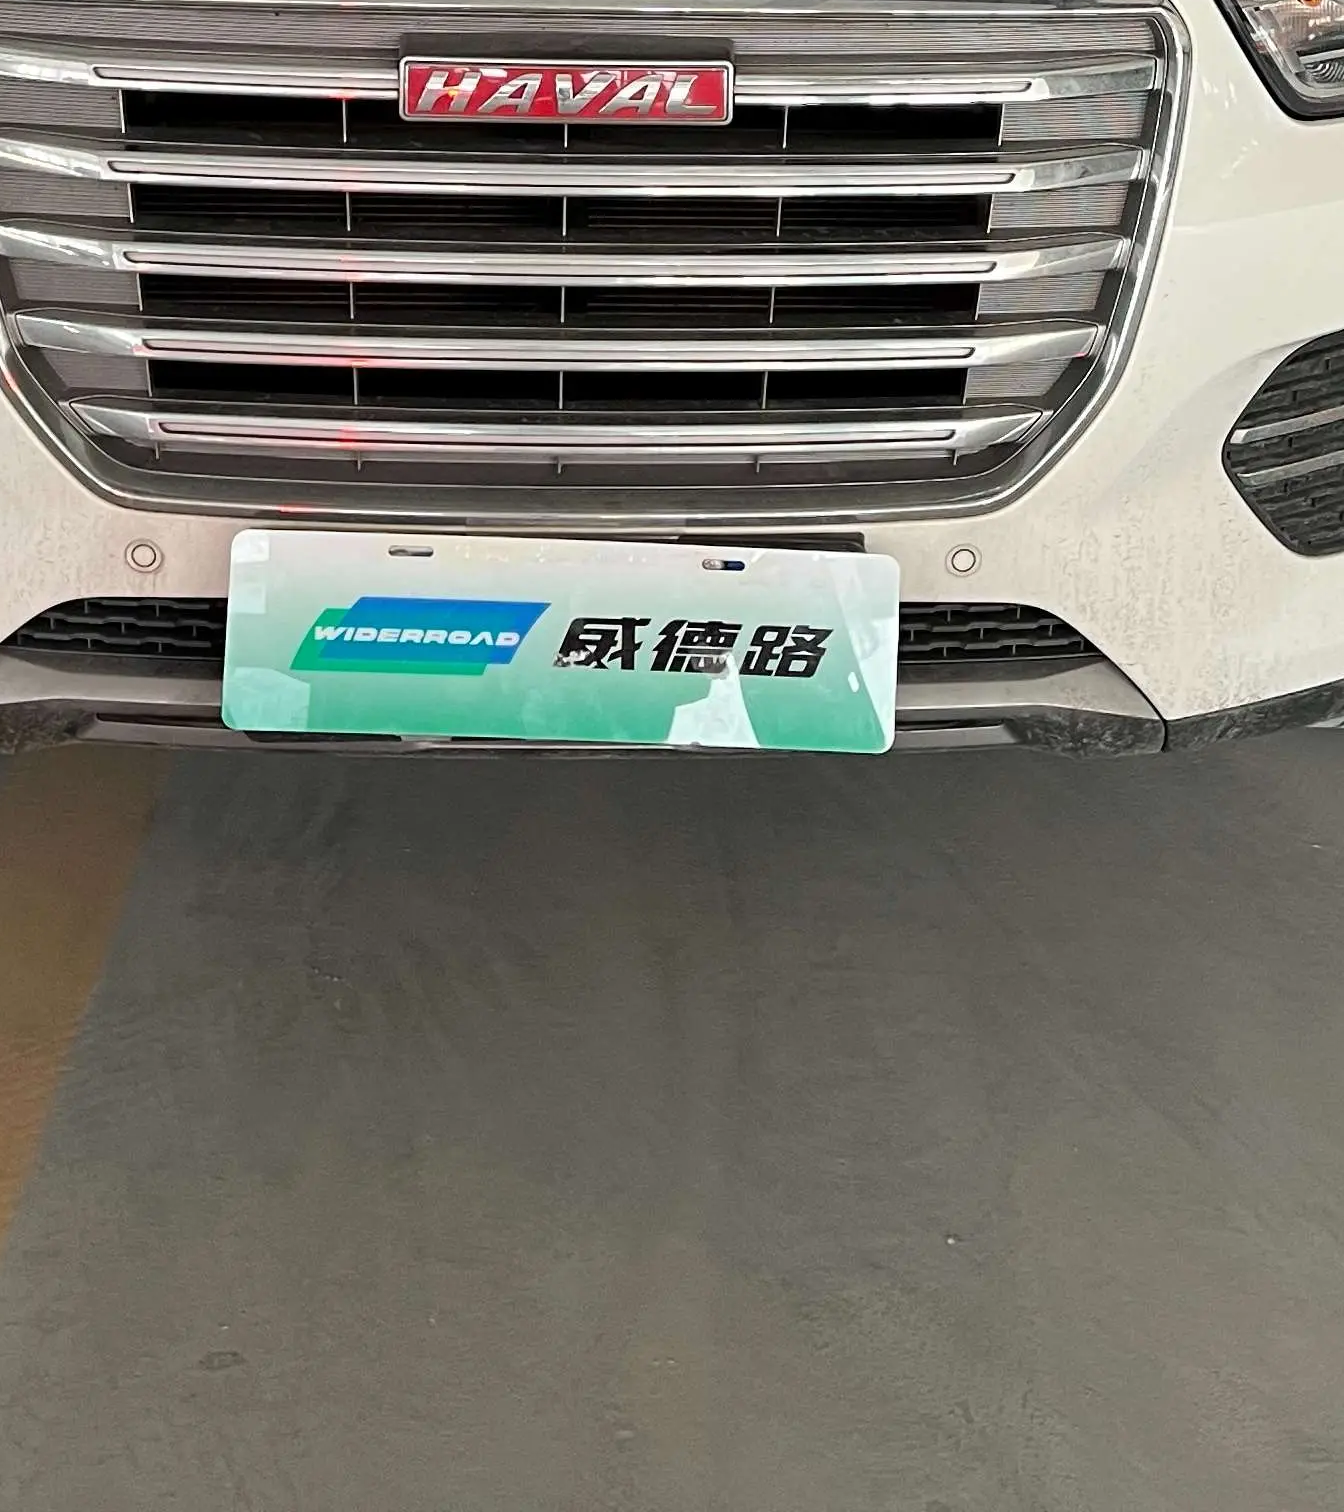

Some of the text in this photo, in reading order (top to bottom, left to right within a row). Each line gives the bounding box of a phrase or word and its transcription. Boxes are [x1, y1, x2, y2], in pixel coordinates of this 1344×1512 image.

[415, 70, 719, 115] HAVAL
[313, 616, 834, 678] WIDERROAD 威德路
